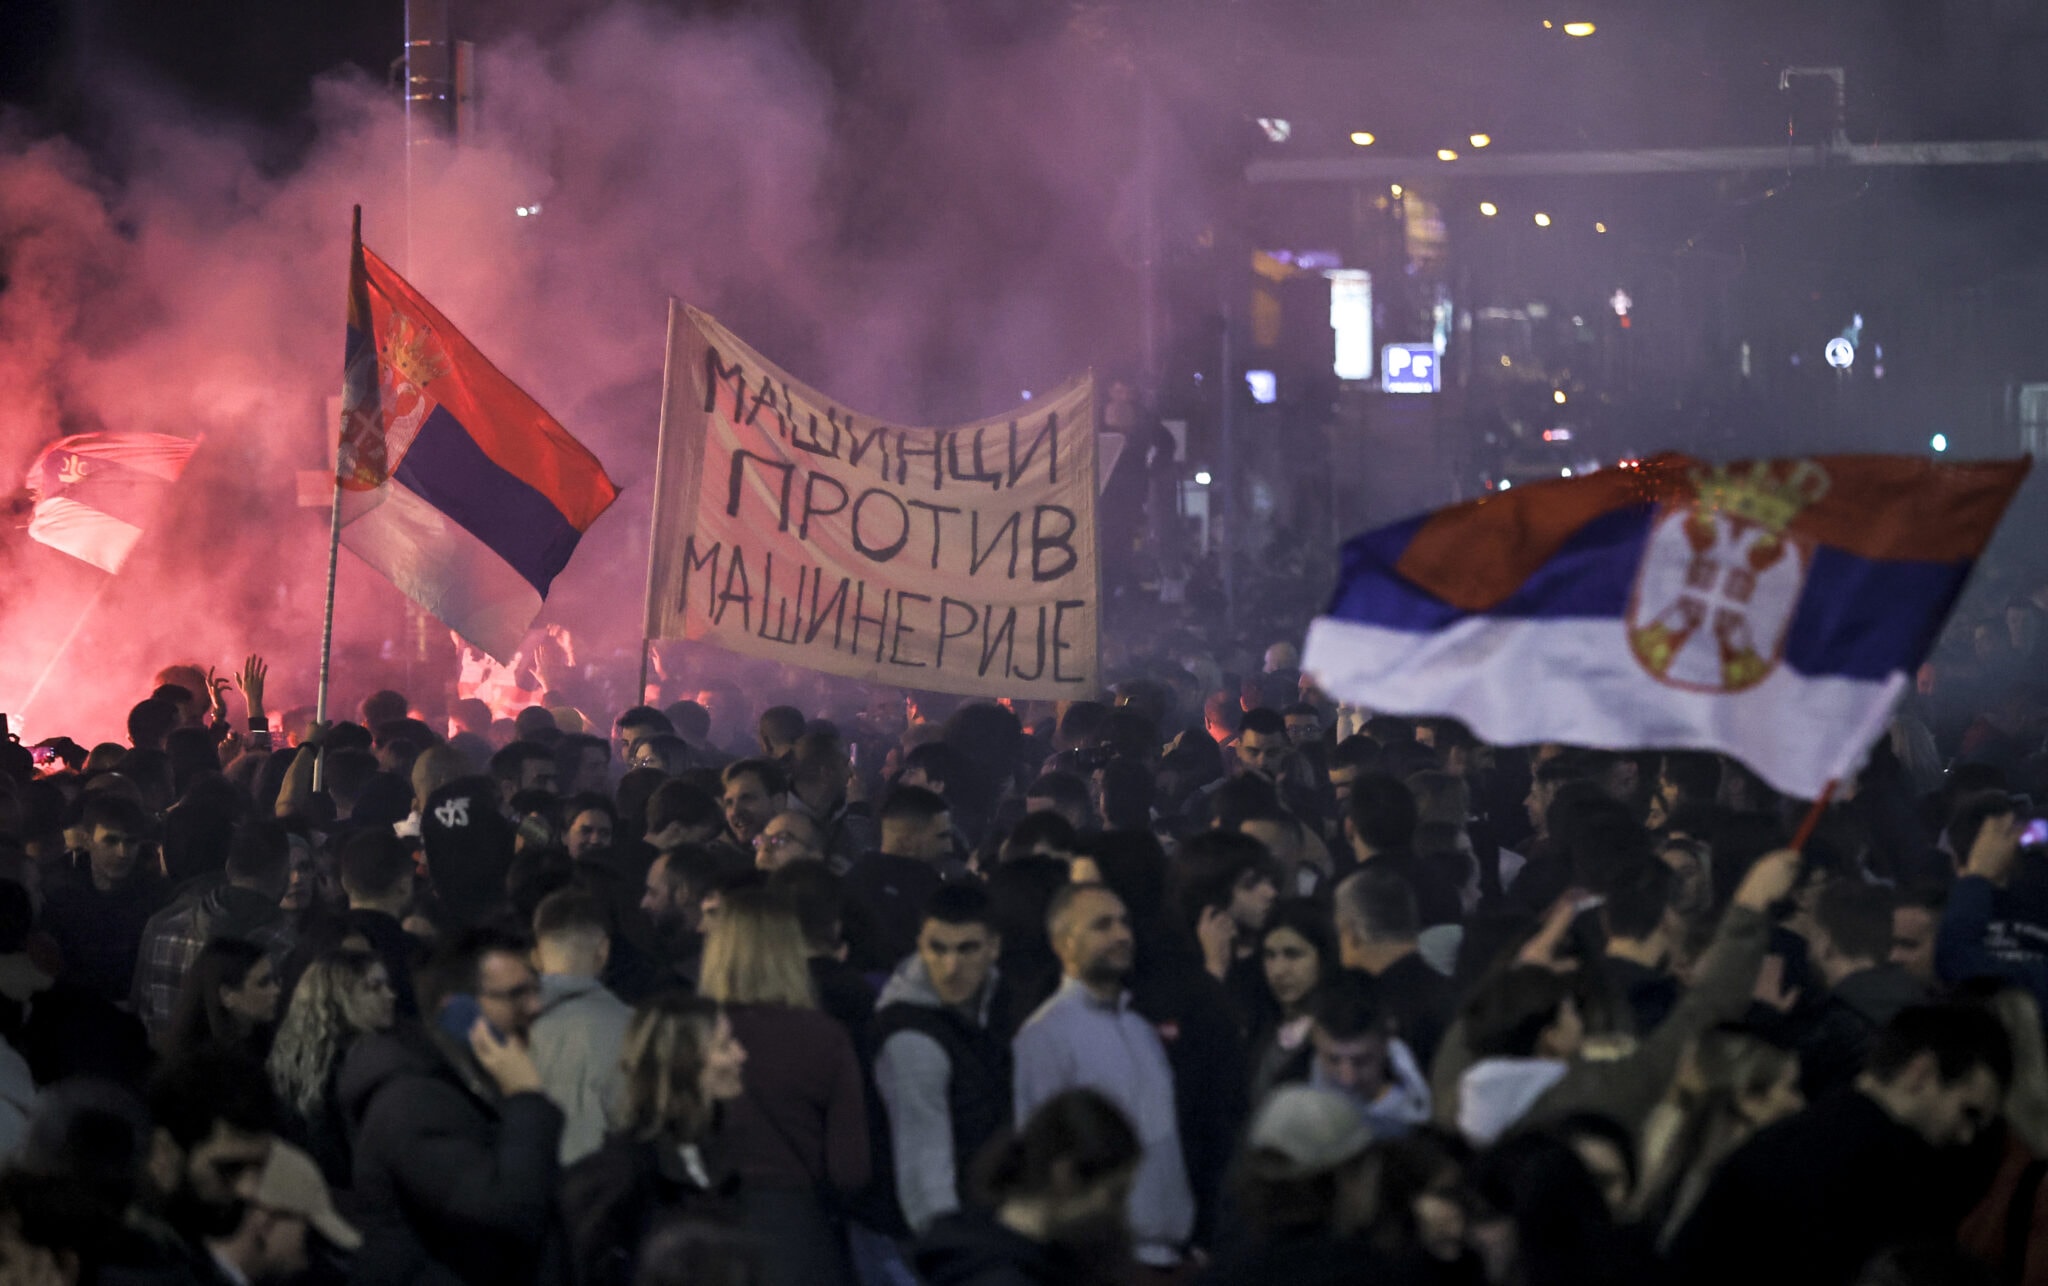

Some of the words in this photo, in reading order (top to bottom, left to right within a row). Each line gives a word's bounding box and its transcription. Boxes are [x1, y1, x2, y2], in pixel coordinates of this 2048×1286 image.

[704, 345, 1058, 491] МАШИНЦИ
[726, 448, 1078, 582] ПРОТИВ
[678, 534, 1086, 683] МАШИНЕРИЈЕ
